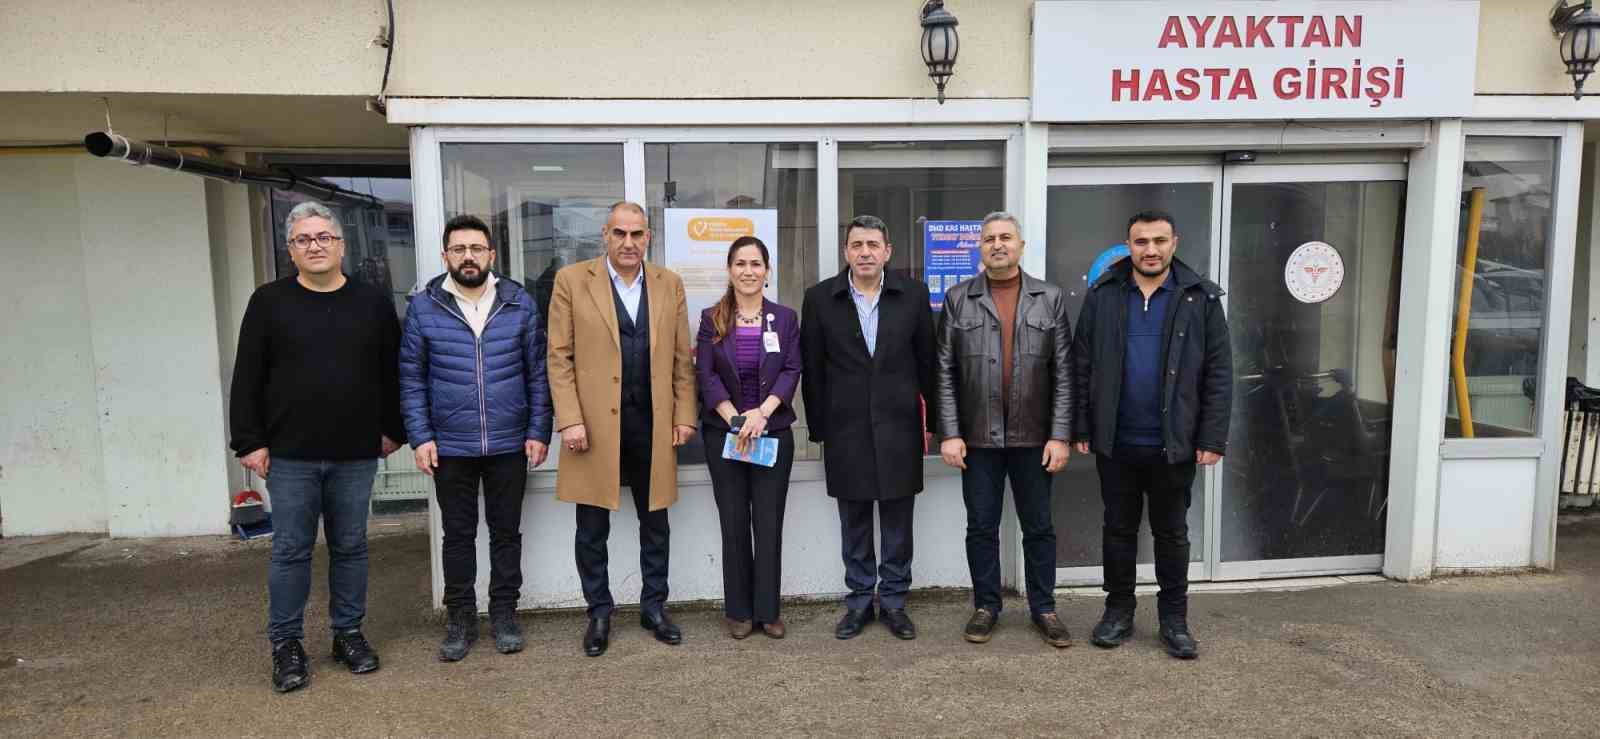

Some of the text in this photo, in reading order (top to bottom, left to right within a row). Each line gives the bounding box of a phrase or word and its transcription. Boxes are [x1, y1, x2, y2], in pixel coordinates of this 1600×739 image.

[1158, 15, 1362, 48] AYAKTAN
[1111, 59, 1406, 107] HASTA GİRİŞİ
